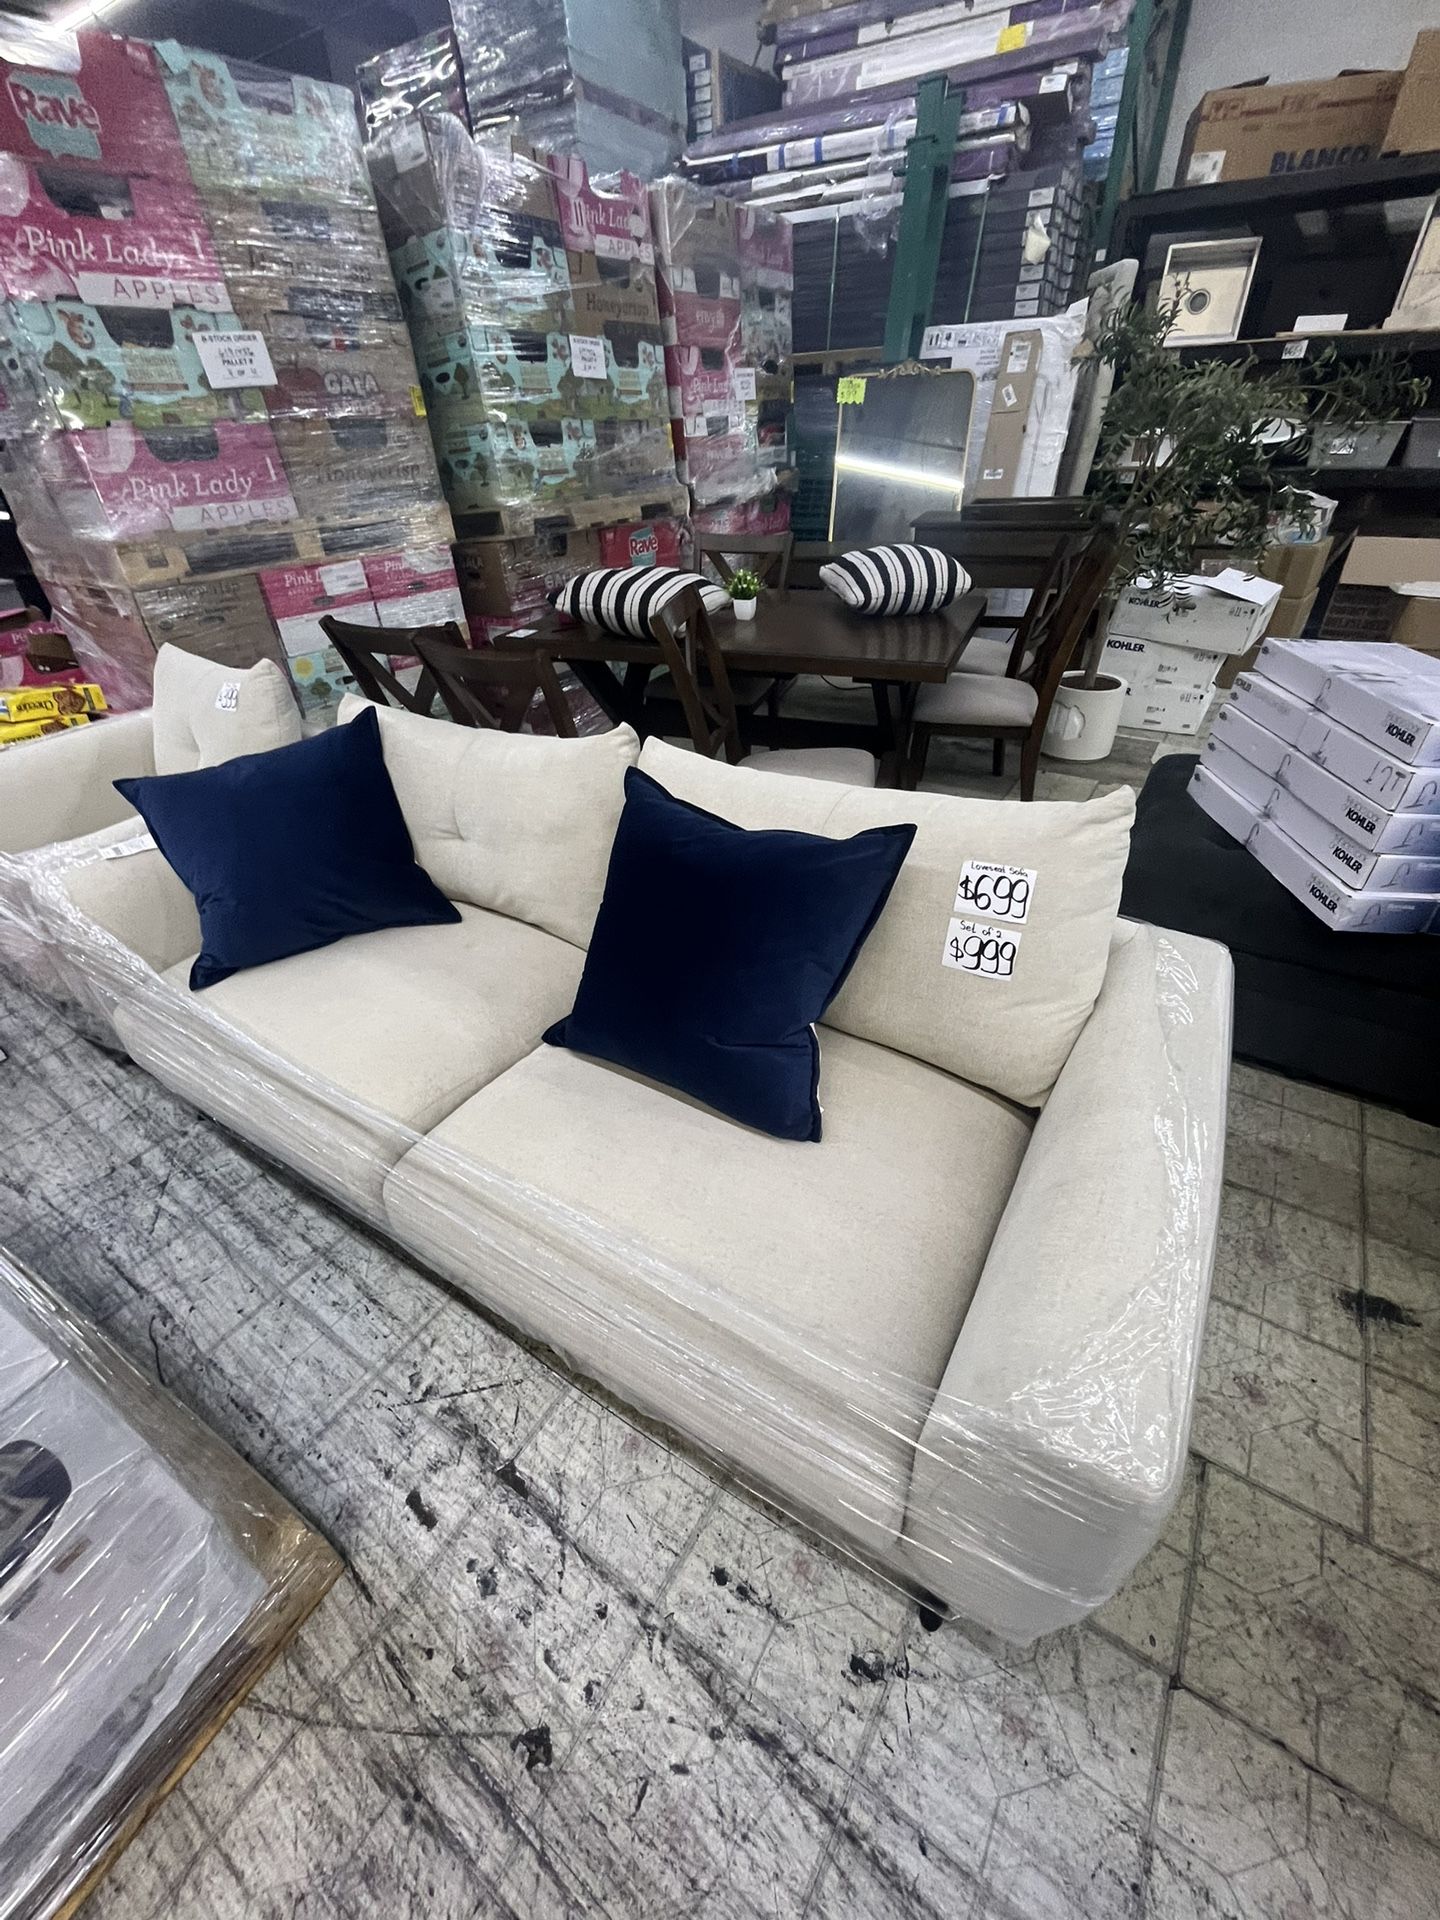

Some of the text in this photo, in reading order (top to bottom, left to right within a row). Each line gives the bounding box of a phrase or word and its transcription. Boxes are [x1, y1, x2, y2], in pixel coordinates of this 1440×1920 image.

[9, 81, 100, 129] Rave
[1270, 144, 1371, 175] BLANCO
[23, 224, 173, 276] Pink Lady
[113, 278, 220, 304] APPLES
[323, 369, 381, 397] GALA
[128, 467, 253, 501] Pink Lady
[200, 500, 290, 522] APPLES
[628, 532, 659, 557] Rave
[285, 568, 316, 588] Pink
[1128, 597, 1161, 609] KOHLER
[1106, 638, 1146, 653] KOHLER
[1385, 722, 1416, 748] KOHLER
[1345, 807, 1376, 835] KOHLER
[971, 861, 1029, 879] Loveseat Sofa
[1332, 846, 1363, 874] KOHLER
[958, 874, 1029, 918] $699
[1309, 884, 1339, 914] KOHLER
[960, 920, 976, 934] Set
[982, 926, 995, 936] of
[949, 936, 1016, 975] $999
